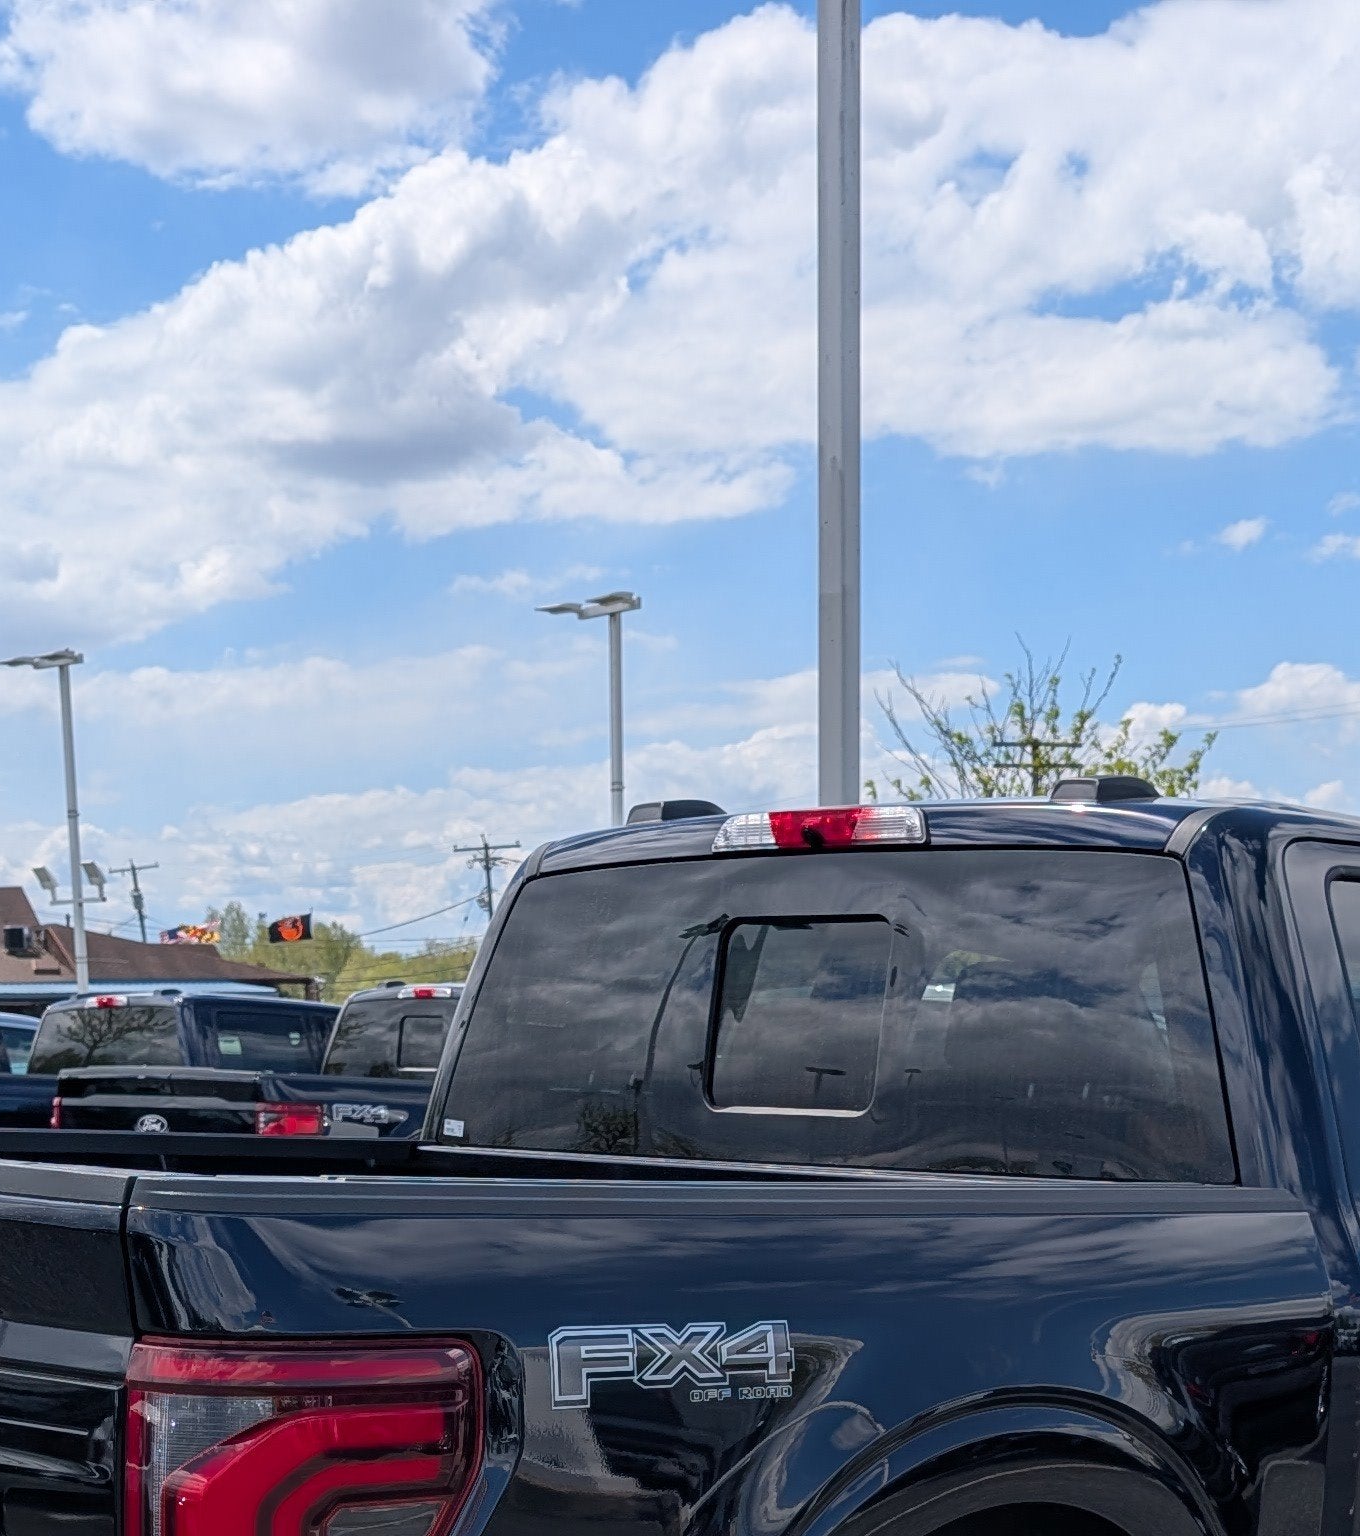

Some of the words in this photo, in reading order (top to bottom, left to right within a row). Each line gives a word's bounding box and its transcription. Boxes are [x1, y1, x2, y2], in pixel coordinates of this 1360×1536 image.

[548, 1319, 795, 1410] FX4
[690, 1388, 732, 1403] OFF
[739, 1385, 793, 1401] ROAD
